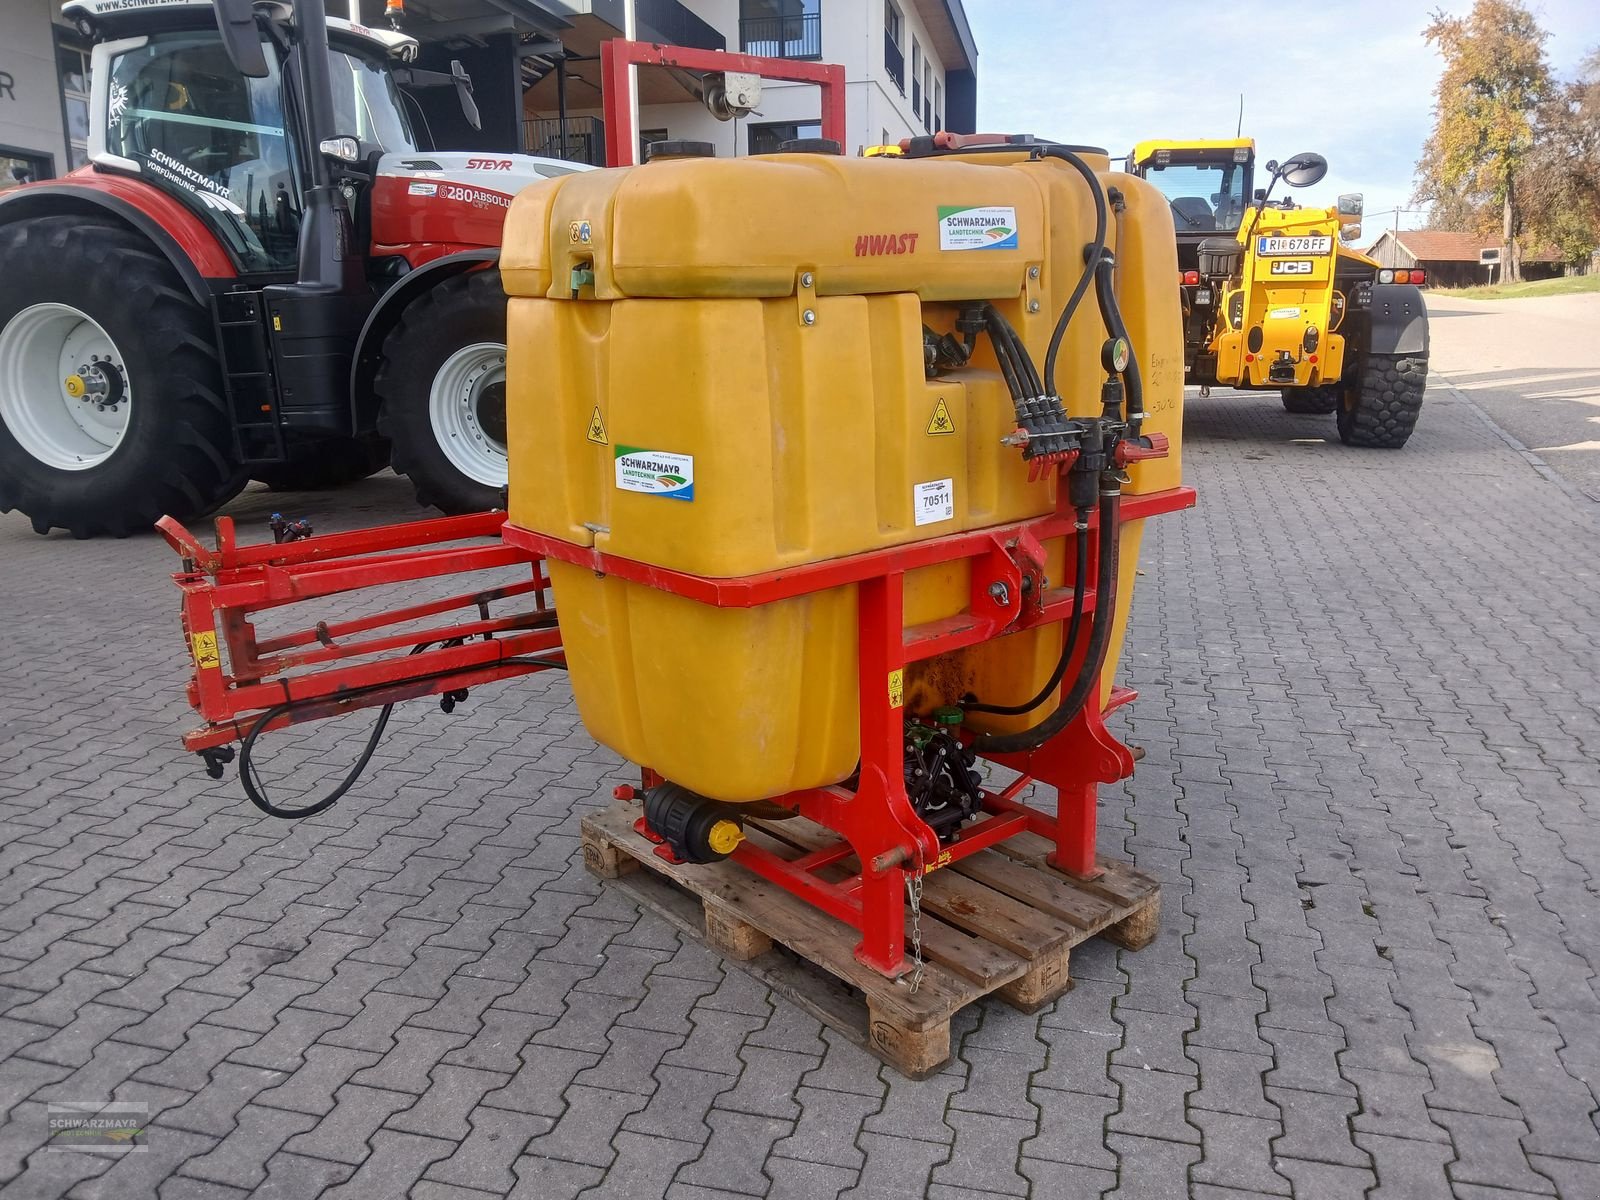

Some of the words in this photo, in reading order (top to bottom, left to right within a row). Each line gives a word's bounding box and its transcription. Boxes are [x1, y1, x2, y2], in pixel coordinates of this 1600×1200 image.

[0, 71, 16, 101] R
[150, 148, 230, 198] SCHWARZMAYR
[465, 159, 513, 171] STEYR
[147, 160, 196, 192] VORFÜHRUNG
[439, 185, 473, 203] 6280
[947, 217, 1006, 227] SCHWARZMAYR
[855, 233, 919, 257] HWAST
[1269, 239, 1281, 250] RI
[1289, 239, 1310, 250] 678
[1311, 238, 1326, 249] FF
[1272, 261, 1312, 273] JCB
[621, 456, 680, 475] SCHWARZMAYR
[622, 468, 656, 480] LANDTECHNIK
[923, 492, 949, 507] 70511
